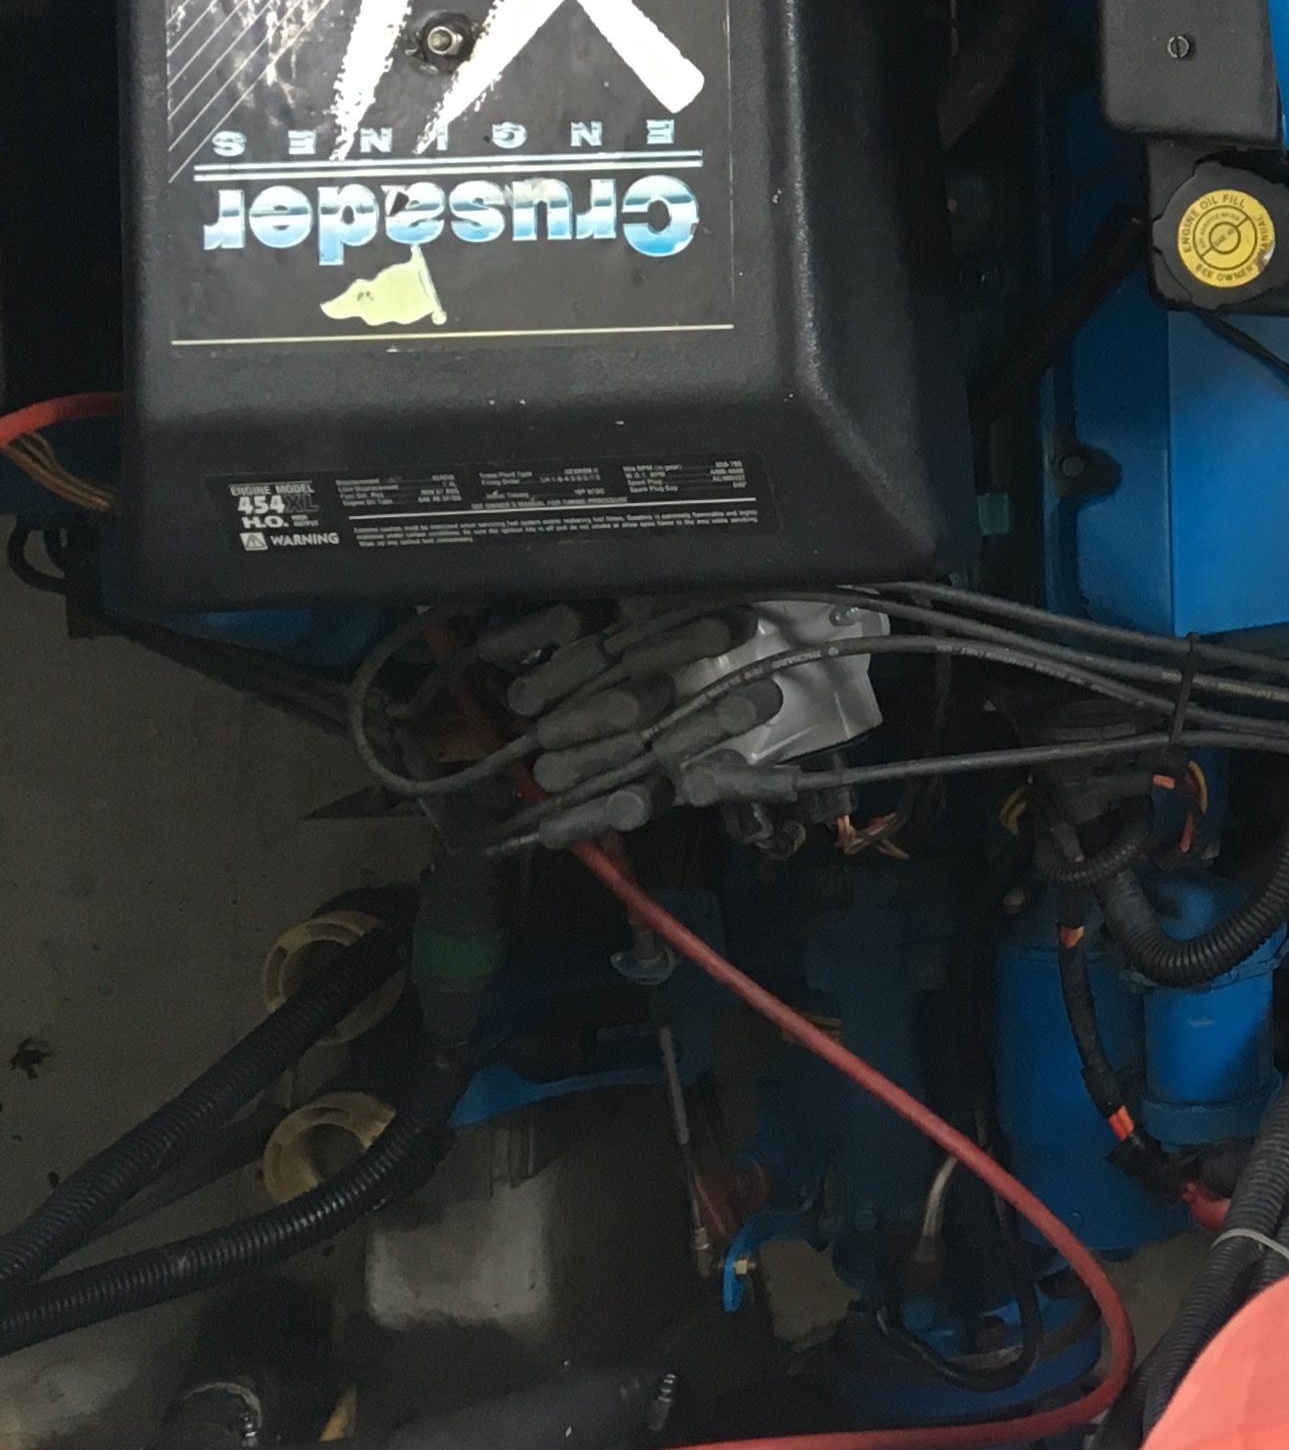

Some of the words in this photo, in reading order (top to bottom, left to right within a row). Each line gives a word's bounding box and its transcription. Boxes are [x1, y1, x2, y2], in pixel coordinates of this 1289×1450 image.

[212, 119, 674, 156] ENGINES
[203, 175, 699, 266] Crusader
[1182, 208, 1199, 253] ENGINE
[1200, 195, 1218, 209] OIL
[1223, 194, 1245, 208] FILL
[1195, 263, 1214, 278] SEE
[230, 485, 271, 496] ENGINE
[275, 483, 315, 494] MODEL
[238, 493, 319, 515] 454XL
[241, 515, 289, 529] H.O.
[270, 532, 339, 546] WARNING
